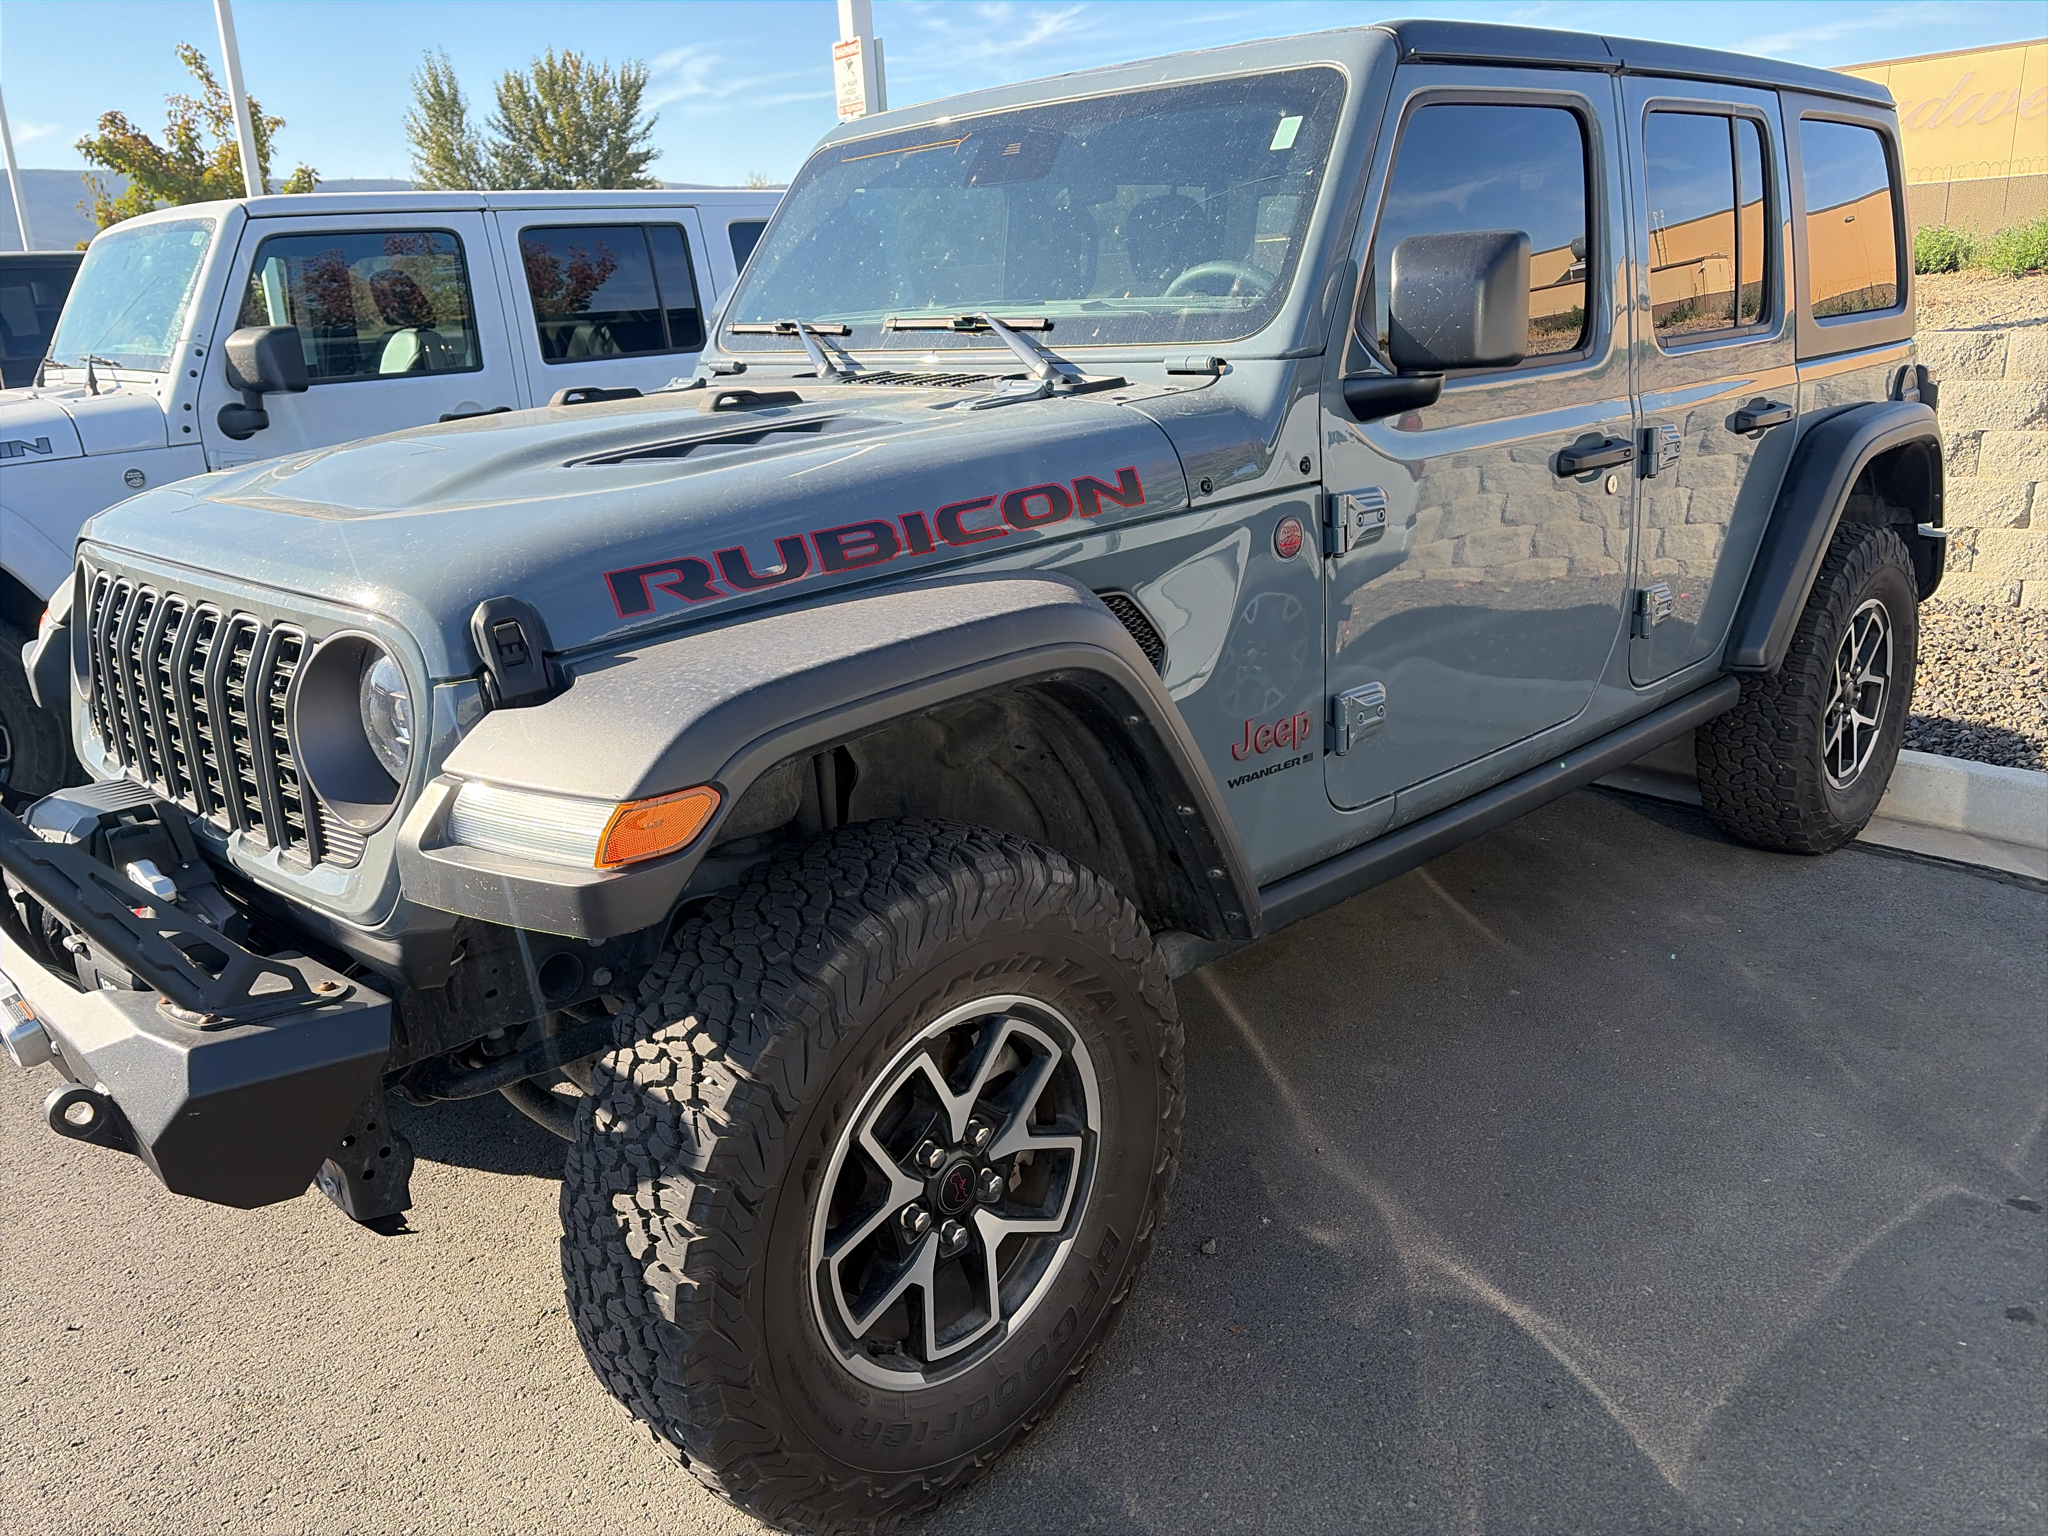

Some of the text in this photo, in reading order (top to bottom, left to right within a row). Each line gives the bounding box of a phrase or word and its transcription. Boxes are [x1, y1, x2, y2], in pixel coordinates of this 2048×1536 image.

[603, 466, 1145, 619] RUBICON
[1232, 711, 1313, 761] Jeep
[1227, 757, 1301, 789] WRANGLER
[1053, 956, 1118, 1015] T/A
[852, 1224, 1121, 1450] BFGoodrich
